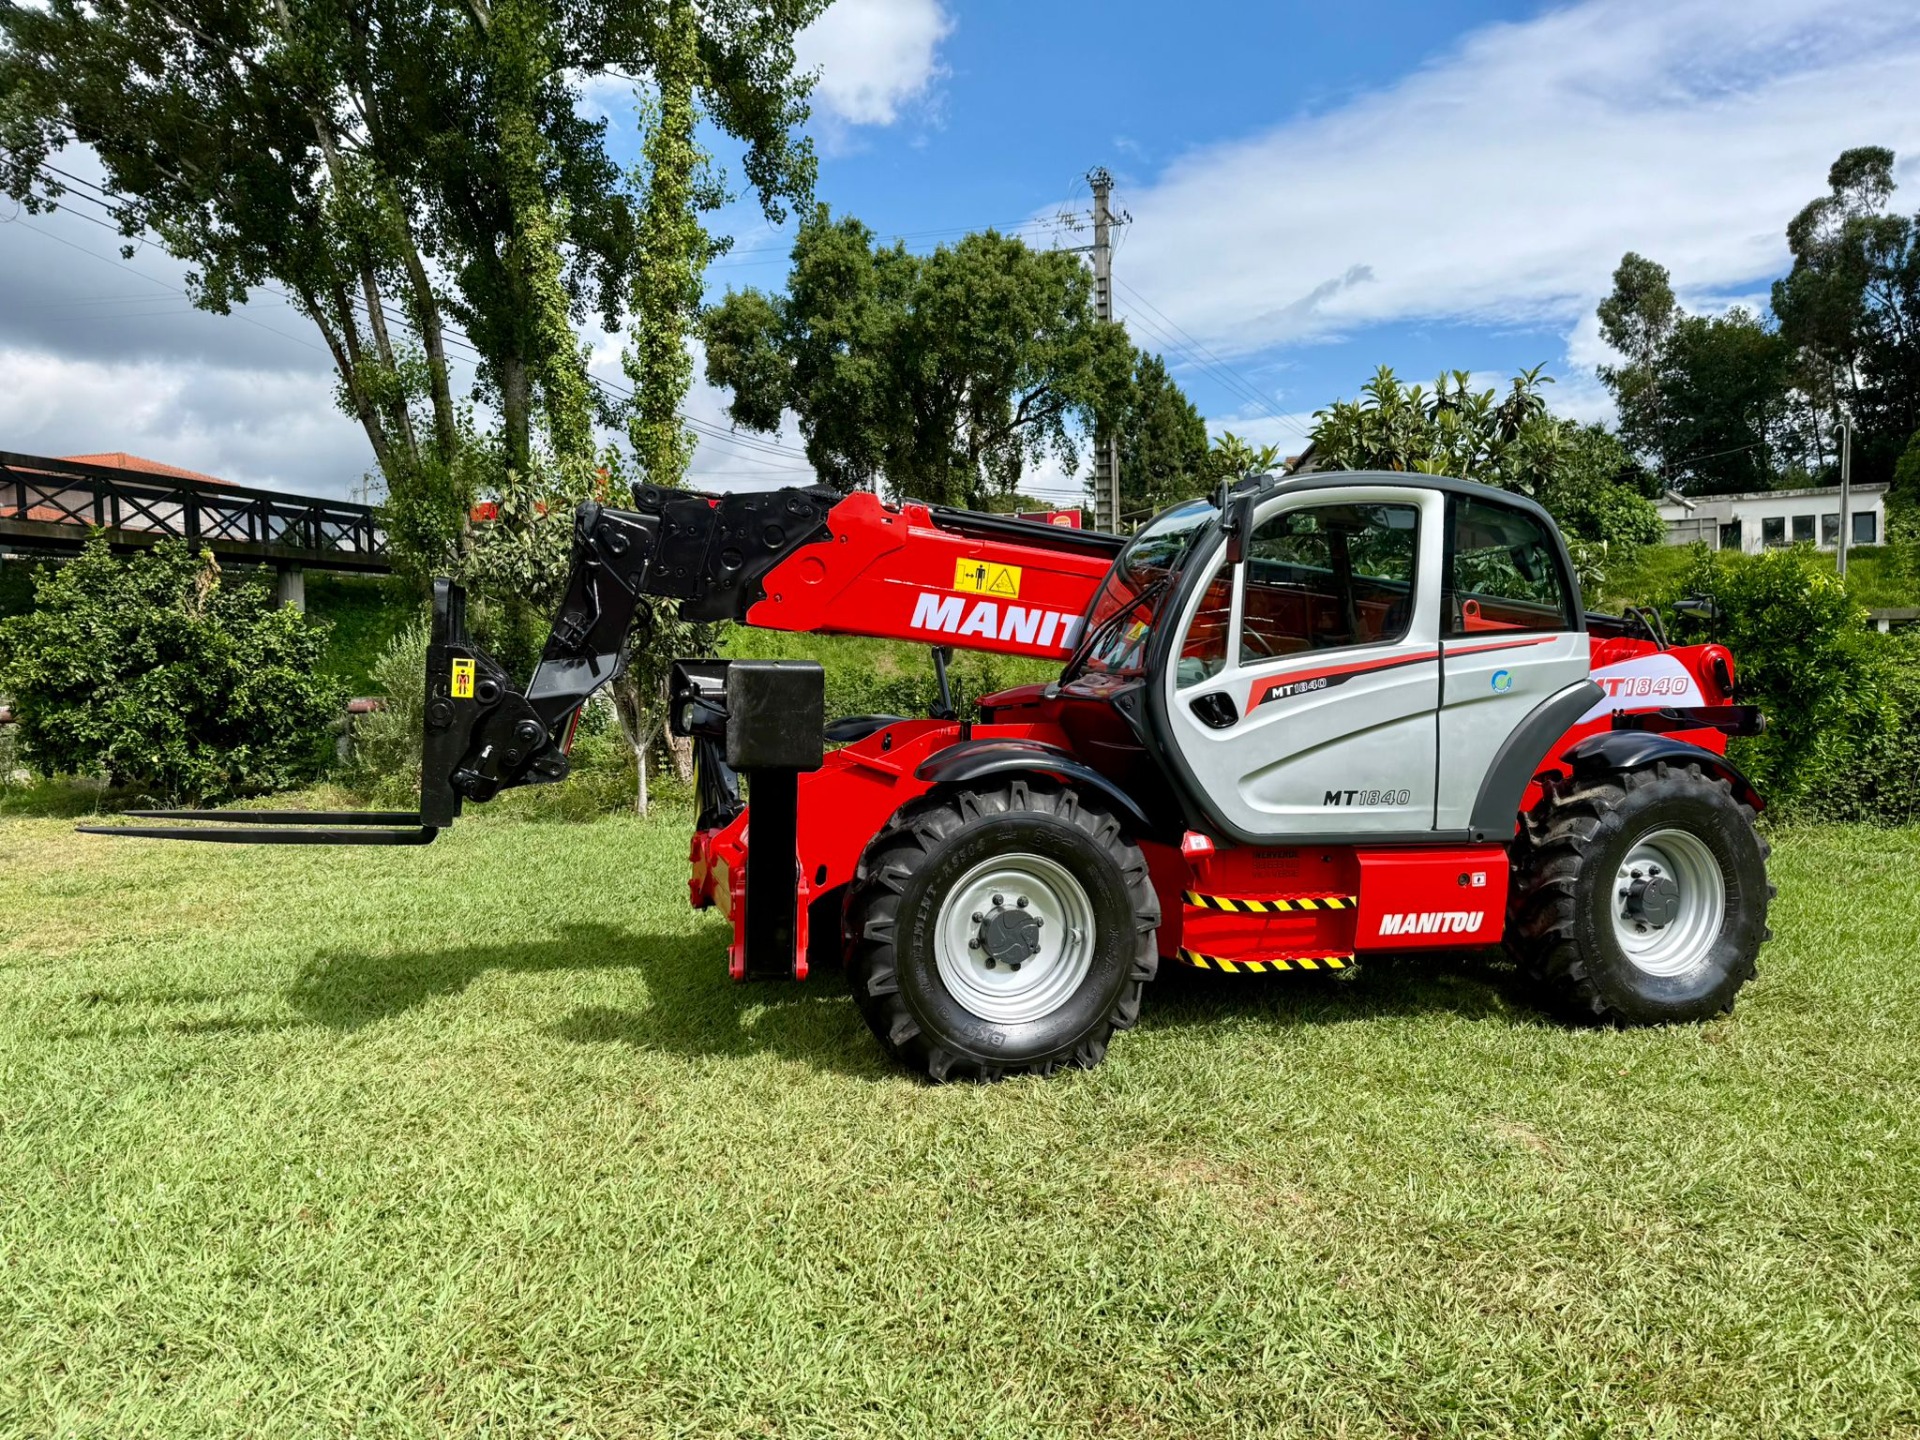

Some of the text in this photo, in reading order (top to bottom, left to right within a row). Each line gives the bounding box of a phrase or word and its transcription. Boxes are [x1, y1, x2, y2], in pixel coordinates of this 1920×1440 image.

[1272, 678, 1327, 698] MT1840
[1323, 789, 1411, 806] MT1840
[1379, 911, 1484, 936] MANITOU
